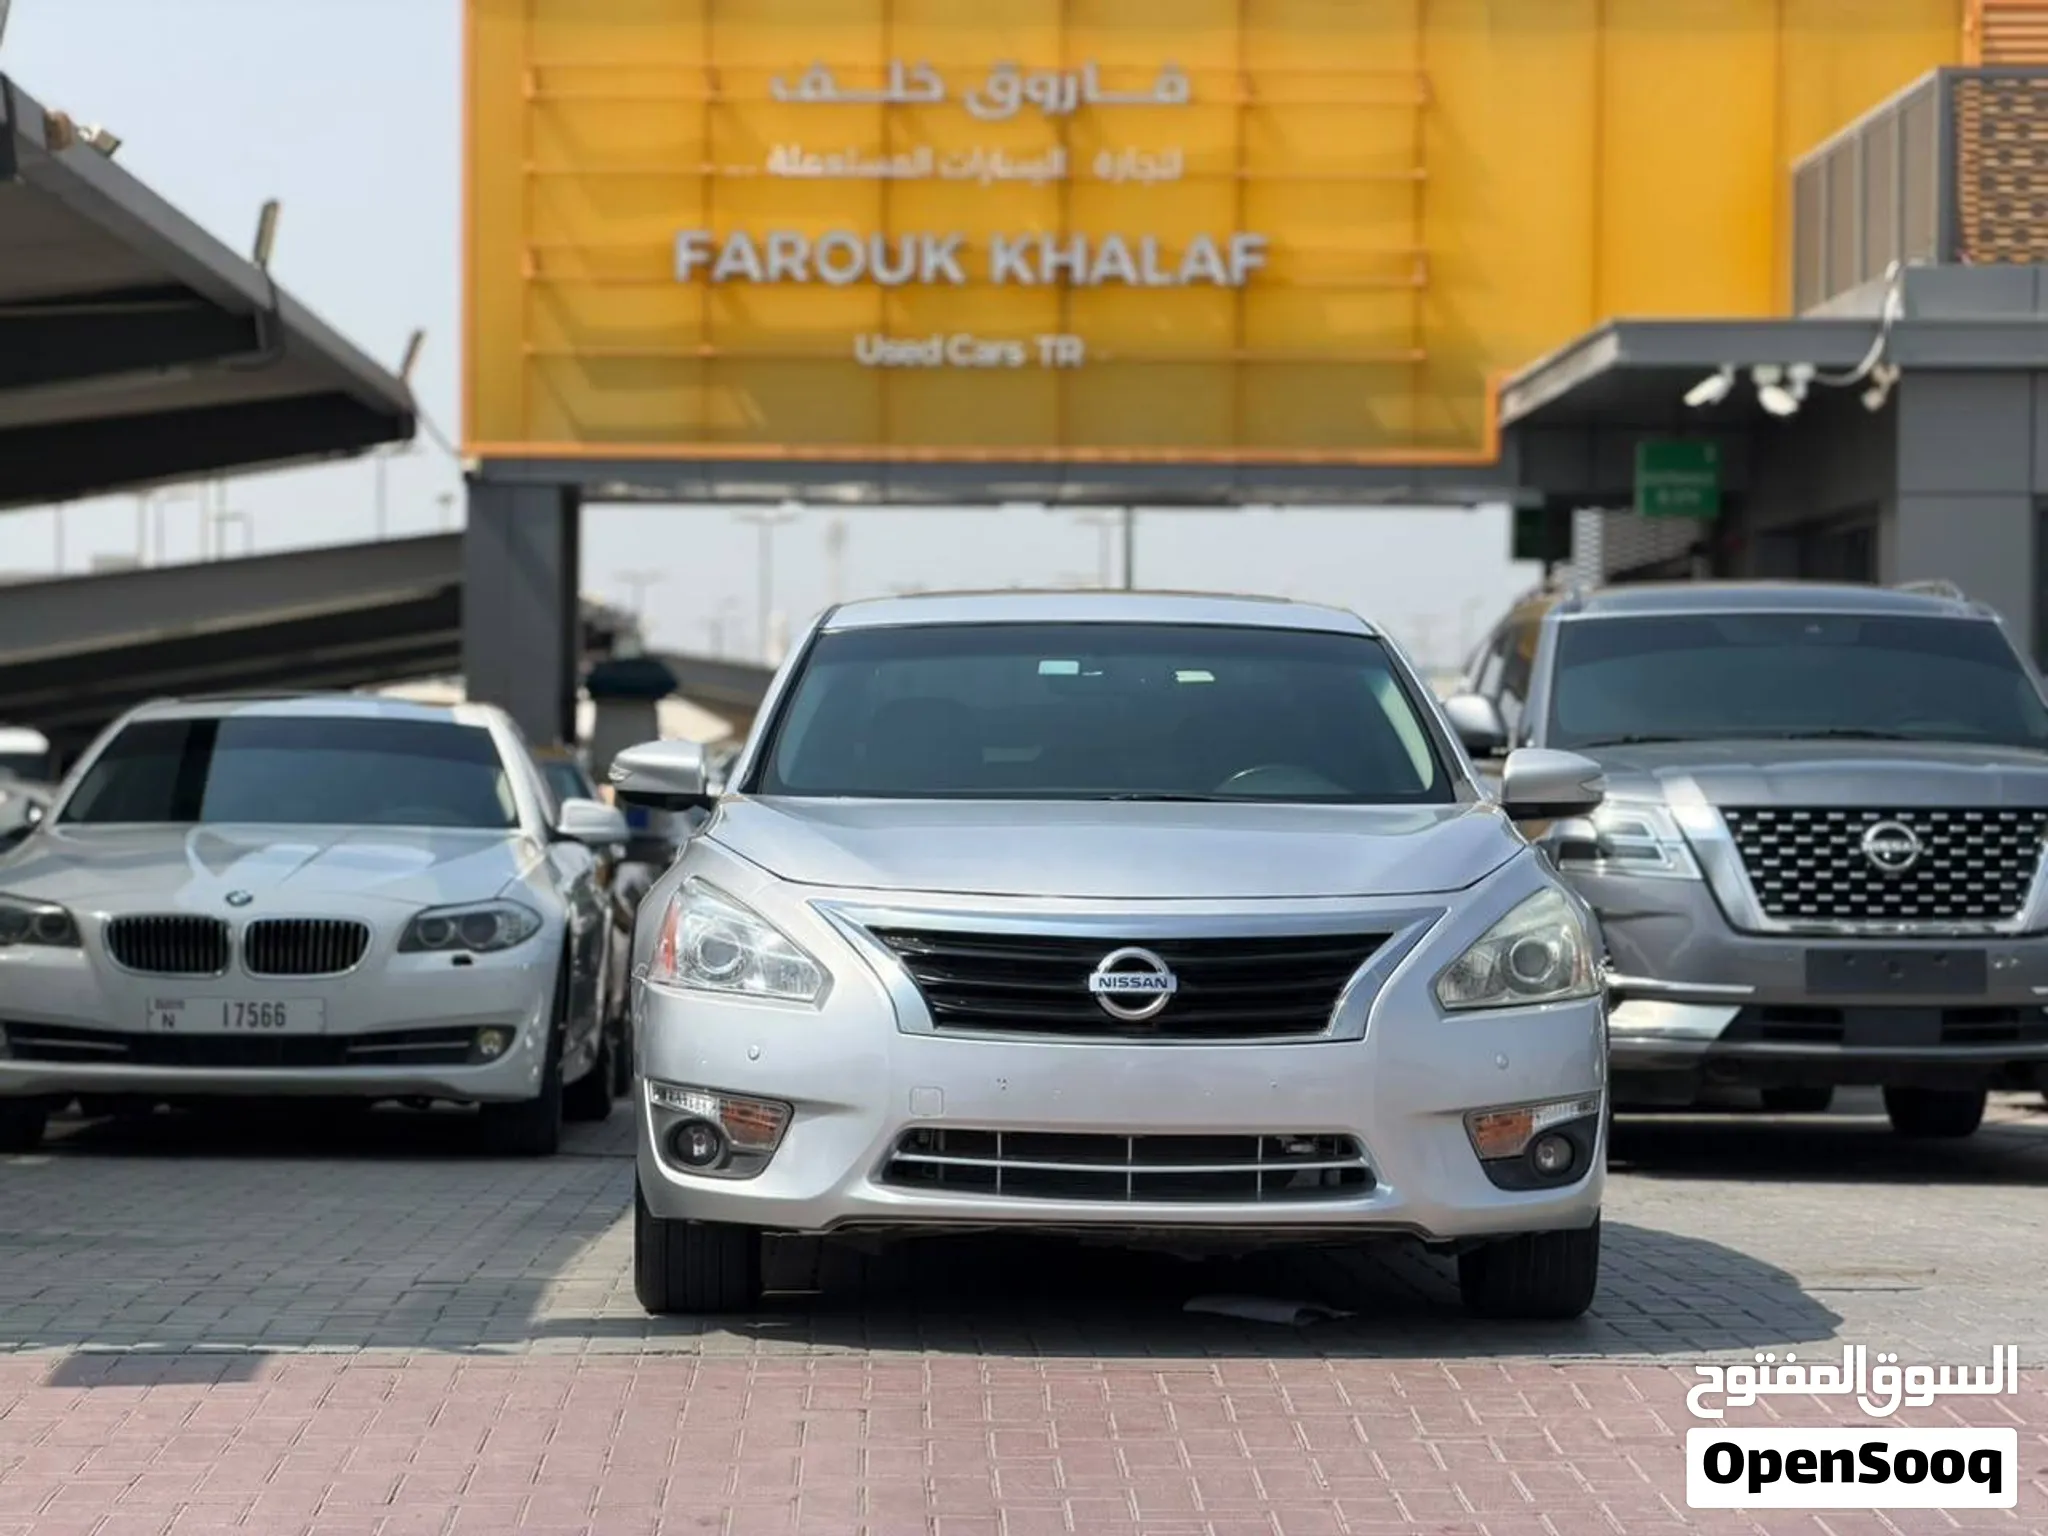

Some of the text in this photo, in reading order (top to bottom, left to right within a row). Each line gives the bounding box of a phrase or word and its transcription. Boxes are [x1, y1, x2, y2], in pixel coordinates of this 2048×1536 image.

[963, 60, 1189, 119] فاروق
[674, 230, 1267, 286] FAROUK KHALAF
[855, 334, 1085, 367] Used Cars TR
[1099, 977, 1167, 988] NISSAN
[162, 1013, 175, 1028] N
[222, 1002, 286, 1028] 17566
